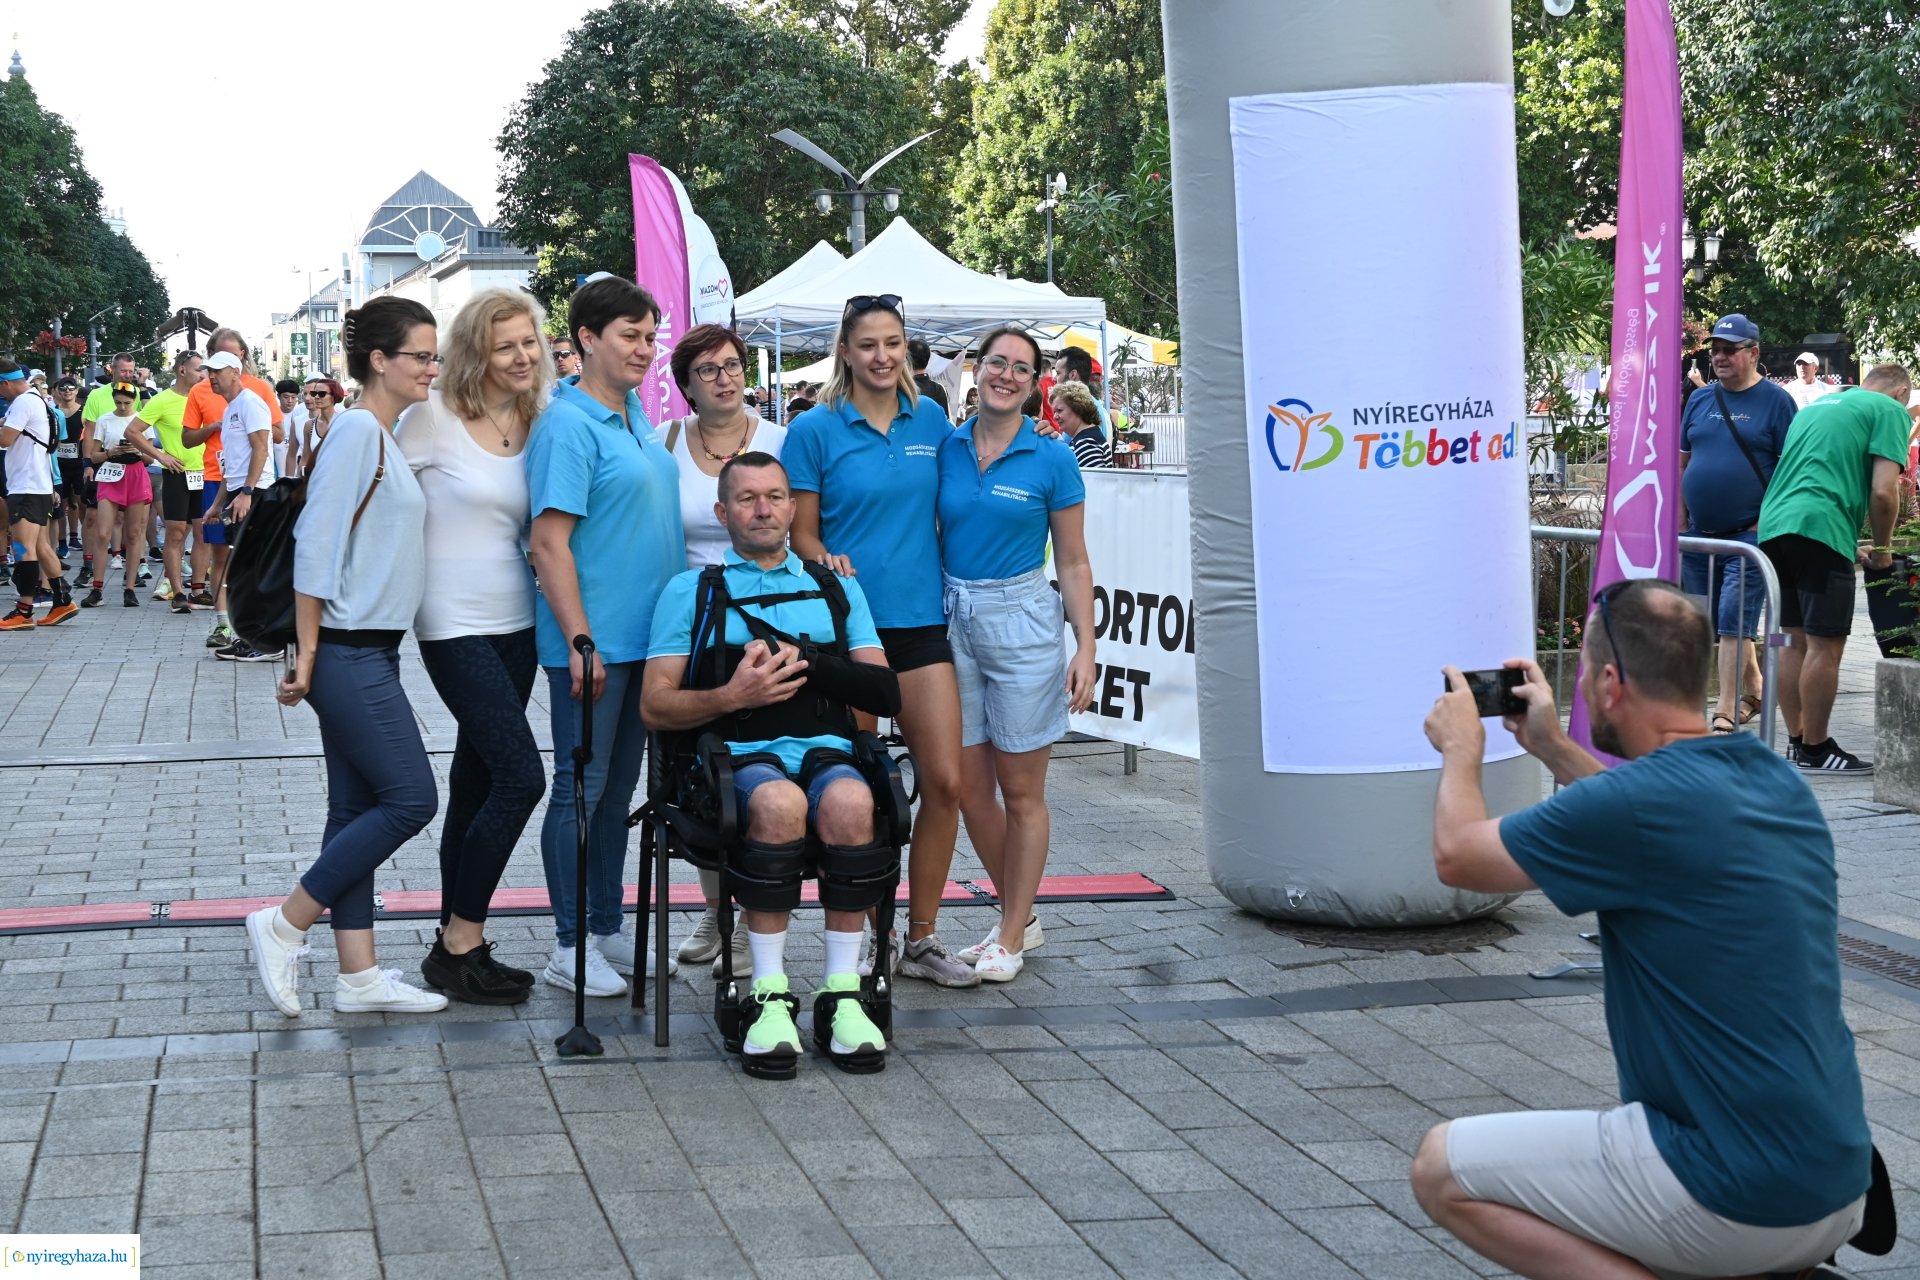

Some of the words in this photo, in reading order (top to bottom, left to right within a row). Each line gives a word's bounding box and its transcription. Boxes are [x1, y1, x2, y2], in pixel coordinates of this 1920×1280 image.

[1354, 397, 1493, 425] NYÍREGYHÁZA
[1354, 428, 1481, 470] Többet
[1487, 422, 1519, 461] ad!
[98, 468, 122, 476] 21156
